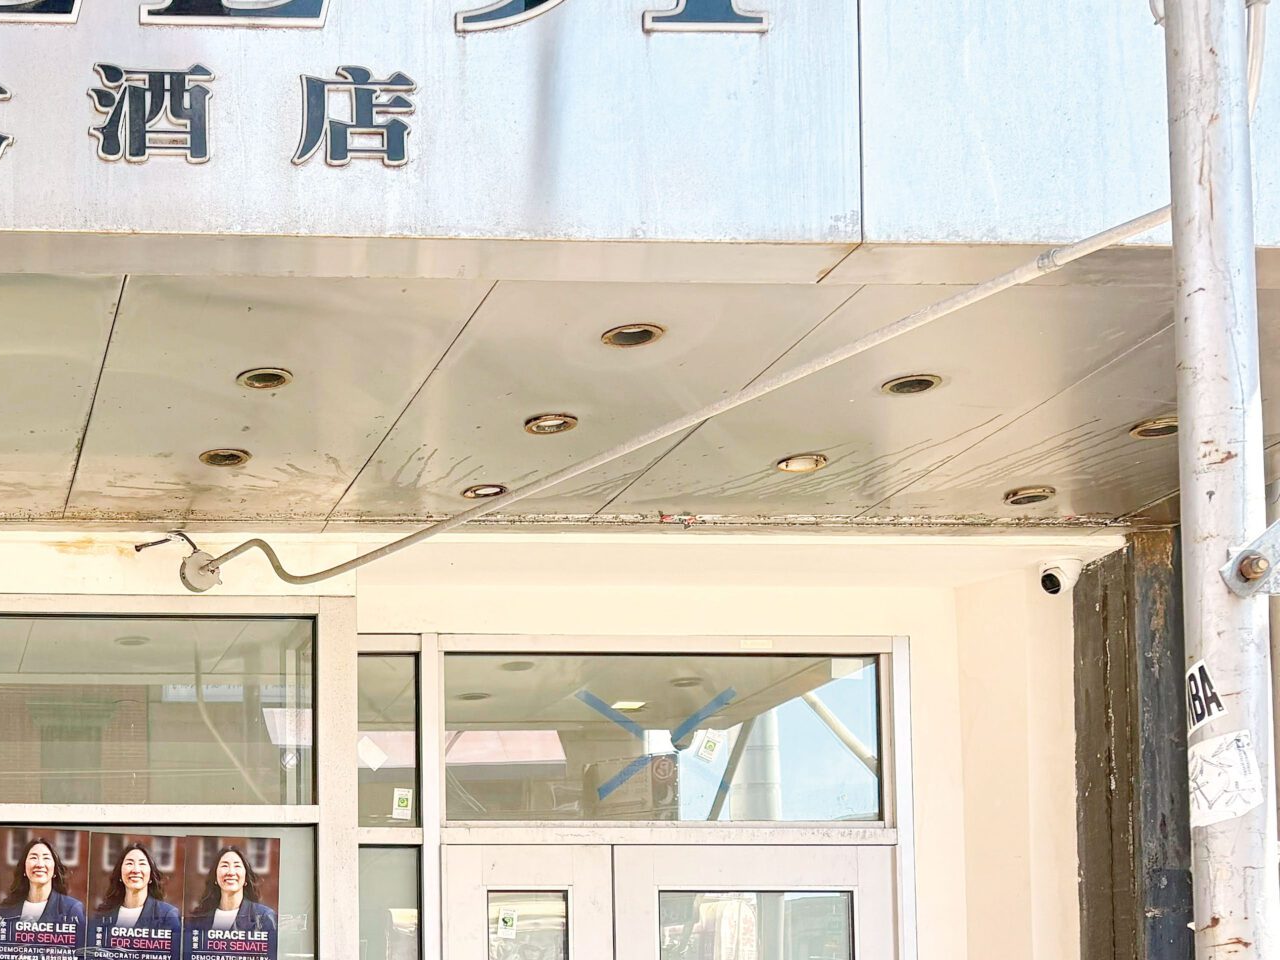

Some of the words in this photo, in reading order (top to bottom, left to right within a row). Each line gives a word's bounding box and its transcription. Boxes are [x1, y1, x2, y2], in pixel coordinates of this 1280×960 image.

[15, 921, 54, 933] GRACE
[55, 923, 77, 934] LEE
[110, 926, 150, 938] GRACE
[151, 928, 172, 939] LEE
[15, 932, 35, 942] FOR
[37, 933, 76, 944] SENATE
[207, 929, 246, 940] GRACE
[247, 930, 269, 941] LEE
[110, 938, 131, 948] FOR
[132, 939, 172, 950] SENATE
[207, 940, 227, 950] FOR
[229, 941, 268, 952] SENATE
[46, 947, 77, 955] PRIMARY
[94, 951, 140, 959] DEMOCRATIC
[141, 953, 172, 960] PRIMARY
